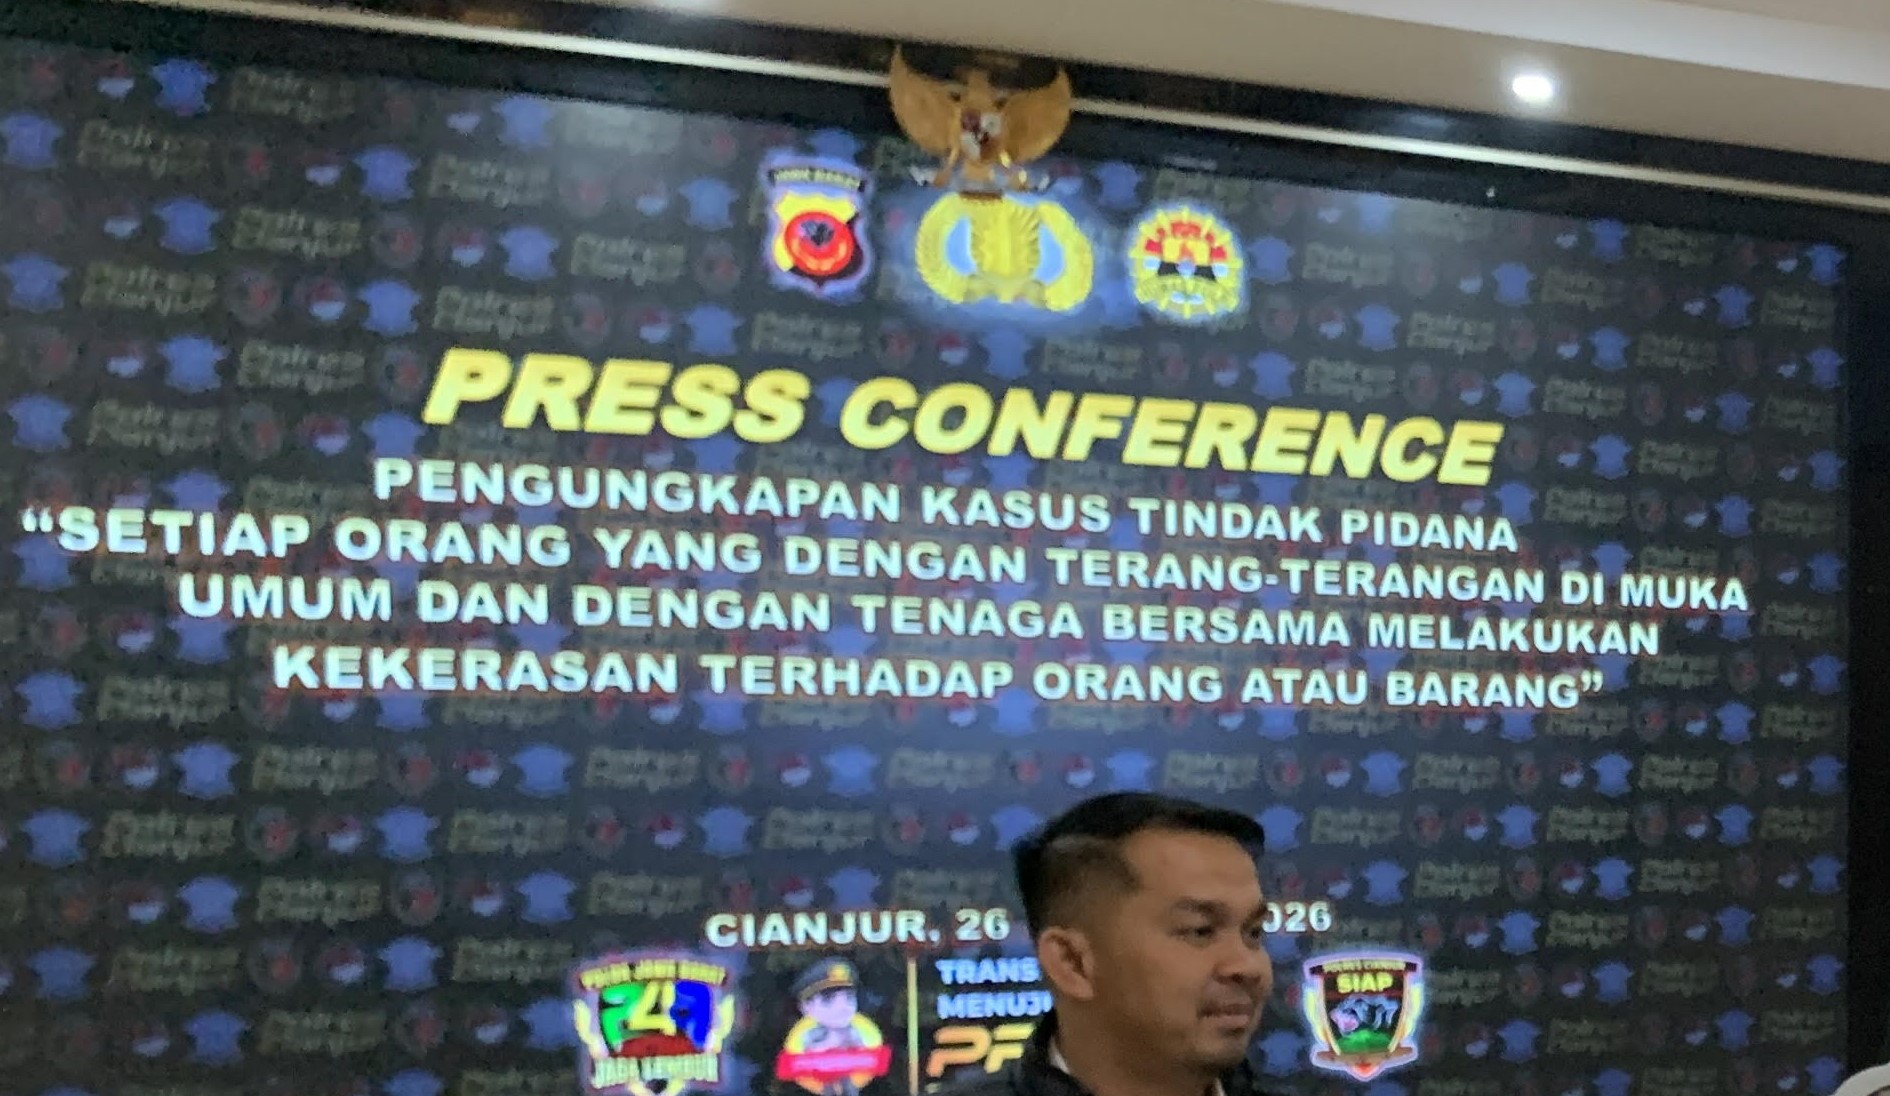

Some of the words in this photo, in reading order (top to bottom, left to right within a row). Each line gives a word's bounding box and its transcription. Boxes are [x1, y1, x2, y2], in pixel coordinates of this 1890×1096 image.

[422, 347, 811, 443] PRESS
[839, 377, 1504, 486] CONFERENCE
[374, 456, 901, 524] PENGUNGKAPAN
[920, 486, 1112, 534] KASUS
[1127, 496, 1323, 544] TINDAK
[1340, 508, 1519, 553] PIDANA
[333, 516, 572, 568] ORANG
[593, 526, 763, 575] YANG
[783, 534, 1027, 585] DENGAN
[1044, 546, 1545, 606] TERANG-TERANGAN
[1560, 570, 1605, 607] DI
[1619, 572, 1749, 612] MUKA
[177, 572, 393, 622] UMUM
[416, 578, 550, 626] DAN
[571, 584, 831, 633] DENGAN
[849, 593, 1085, 640] TENAGA
[1101, 602, 1351, 648] BERSAMA
[1367, 611, 1660, 656] MELAKUKAN
[272, 644, 679, 694] KEKERASAN
[698, 653, 1015, 700] TERHADAP
[1032, 661, 1224, 704] ORANG
[1240, 666, 1369, 706] ATAU
[954, 908, 1011, 941] 26
[1261, 901, 1332, 934] 026
[1336, 971, 1394, 994] SIAP
